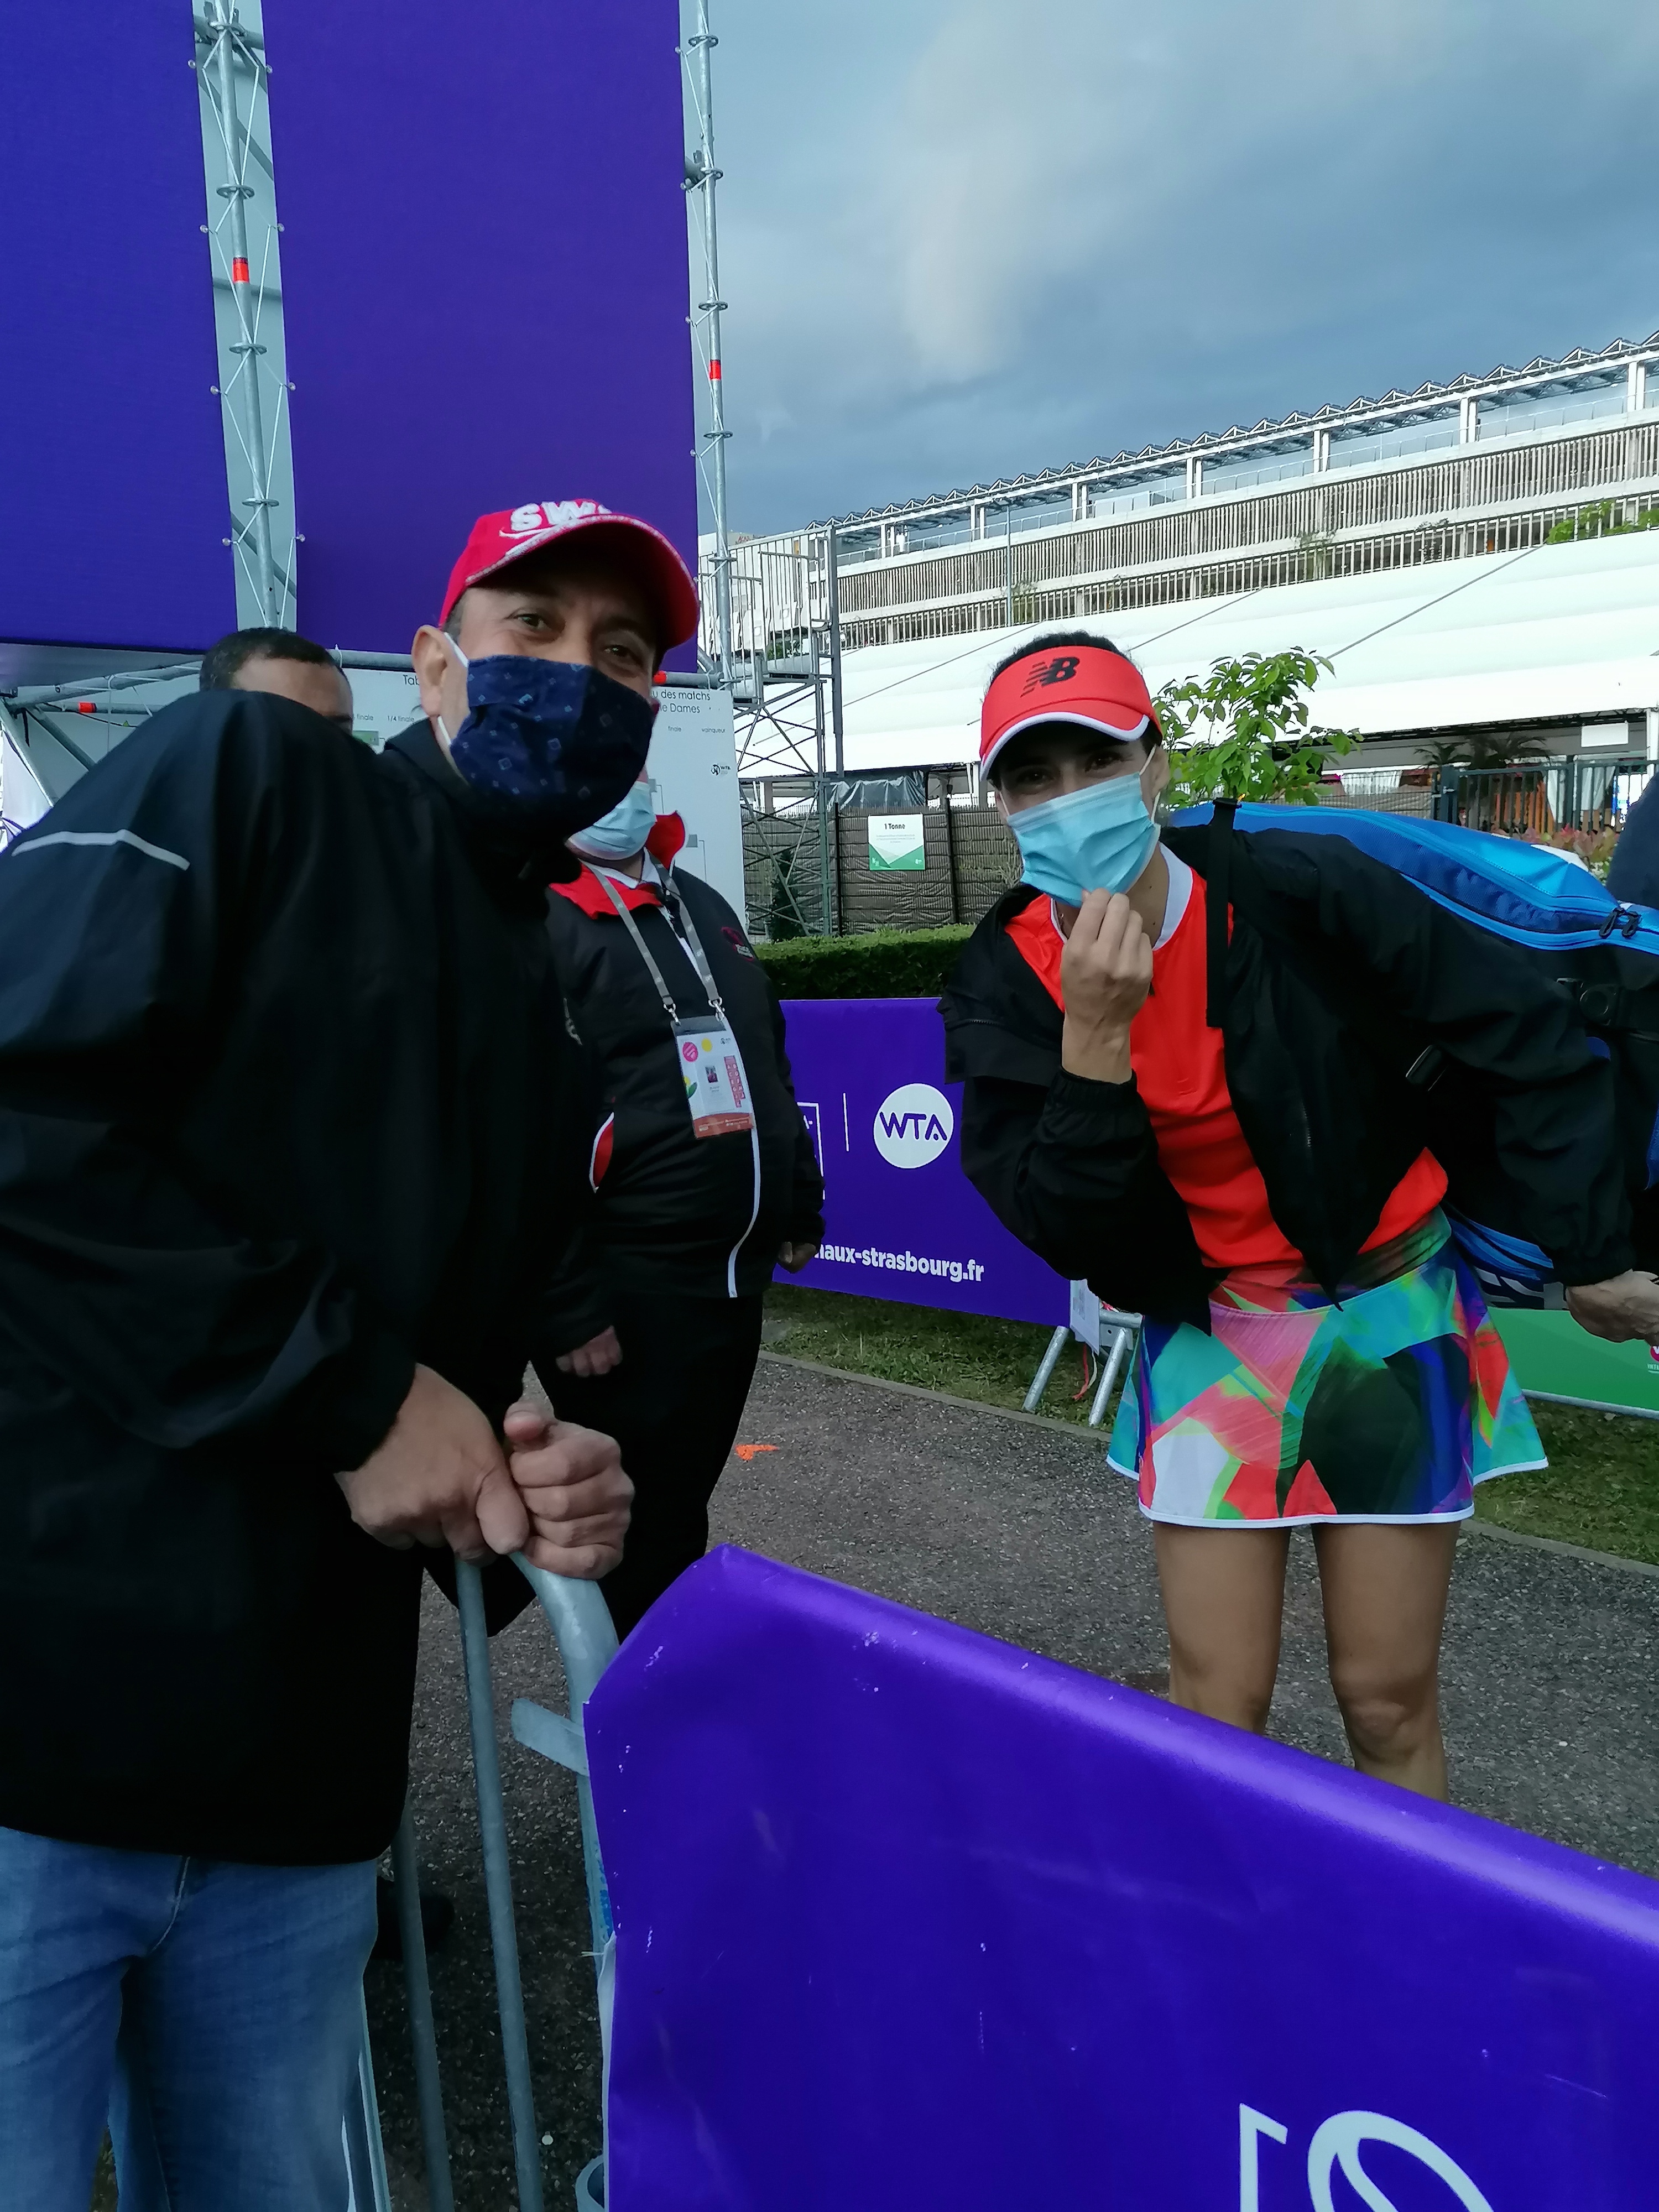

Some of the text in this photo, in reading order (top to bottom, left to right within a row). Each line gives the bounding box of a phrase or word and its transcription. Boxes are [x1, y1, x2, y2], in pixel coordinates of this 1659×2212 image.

[661, 689, 676, 699] des
[679, 691, 711, 701] matchs
[670, 703, 701, 713] Dames
[880, 1112, 947, 1141] WTA
